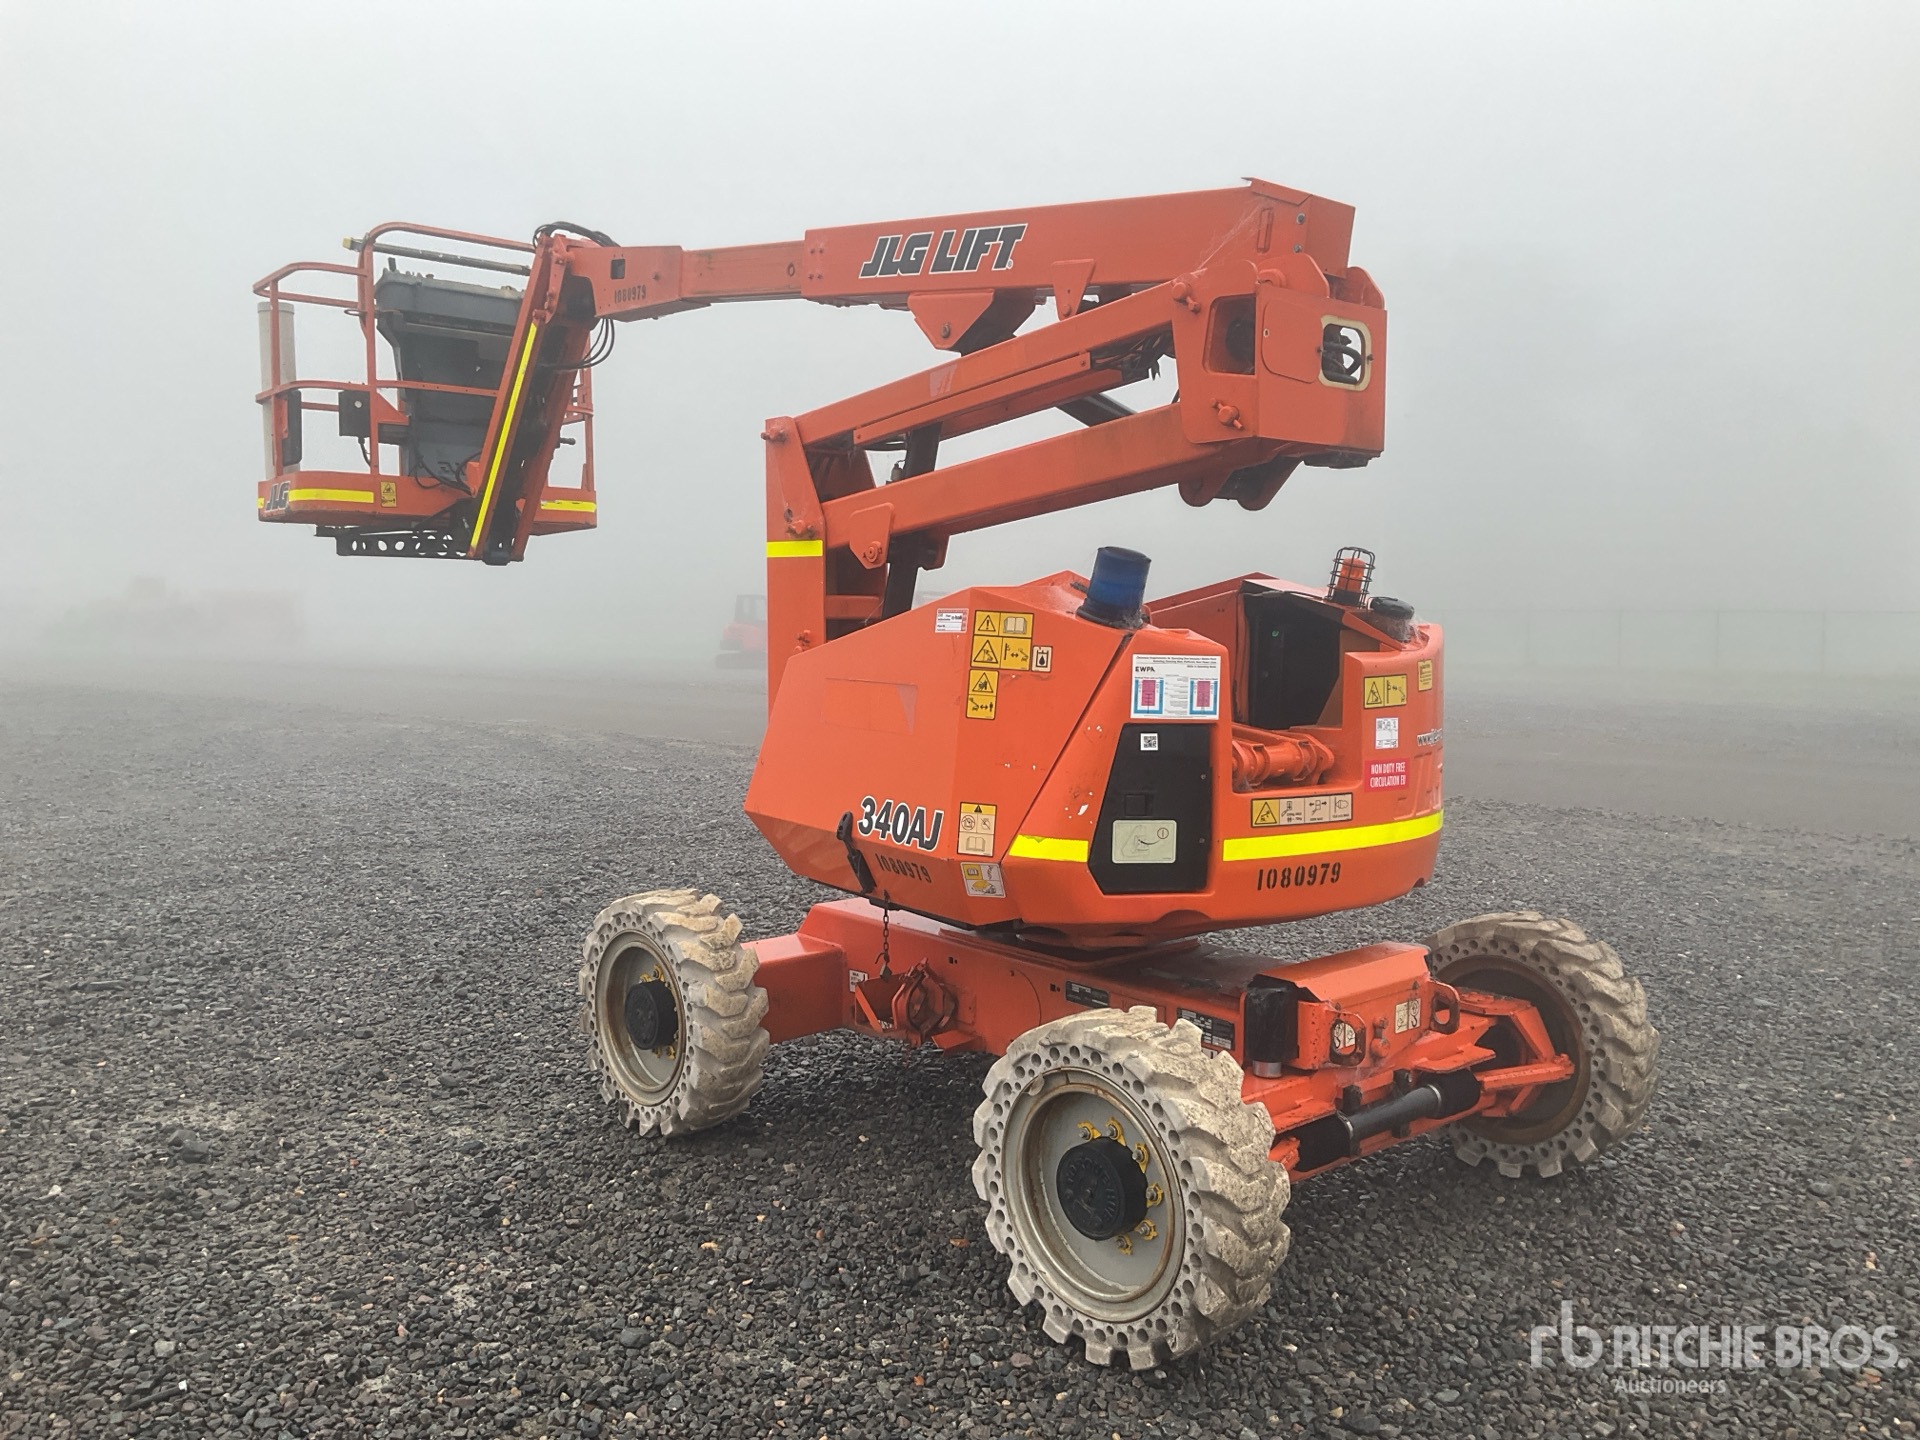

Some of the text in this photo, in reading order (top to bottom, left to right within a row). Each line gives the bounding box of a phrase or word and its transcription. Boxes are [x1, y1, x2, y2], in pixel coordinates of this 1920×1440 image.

[859, 223, 1028, 278] JLG LIFT
[264, 481, 291, 512] JLG
[1369, 775, 1400, 788] CIRCULATION
[1371, 761, 1406, 775] NON DUTY FREE
[857, 795, 944, 852] 340AJ
[875, 853, 932, 884] 1080979
[1256, 862, 1342, 891] 1080979
